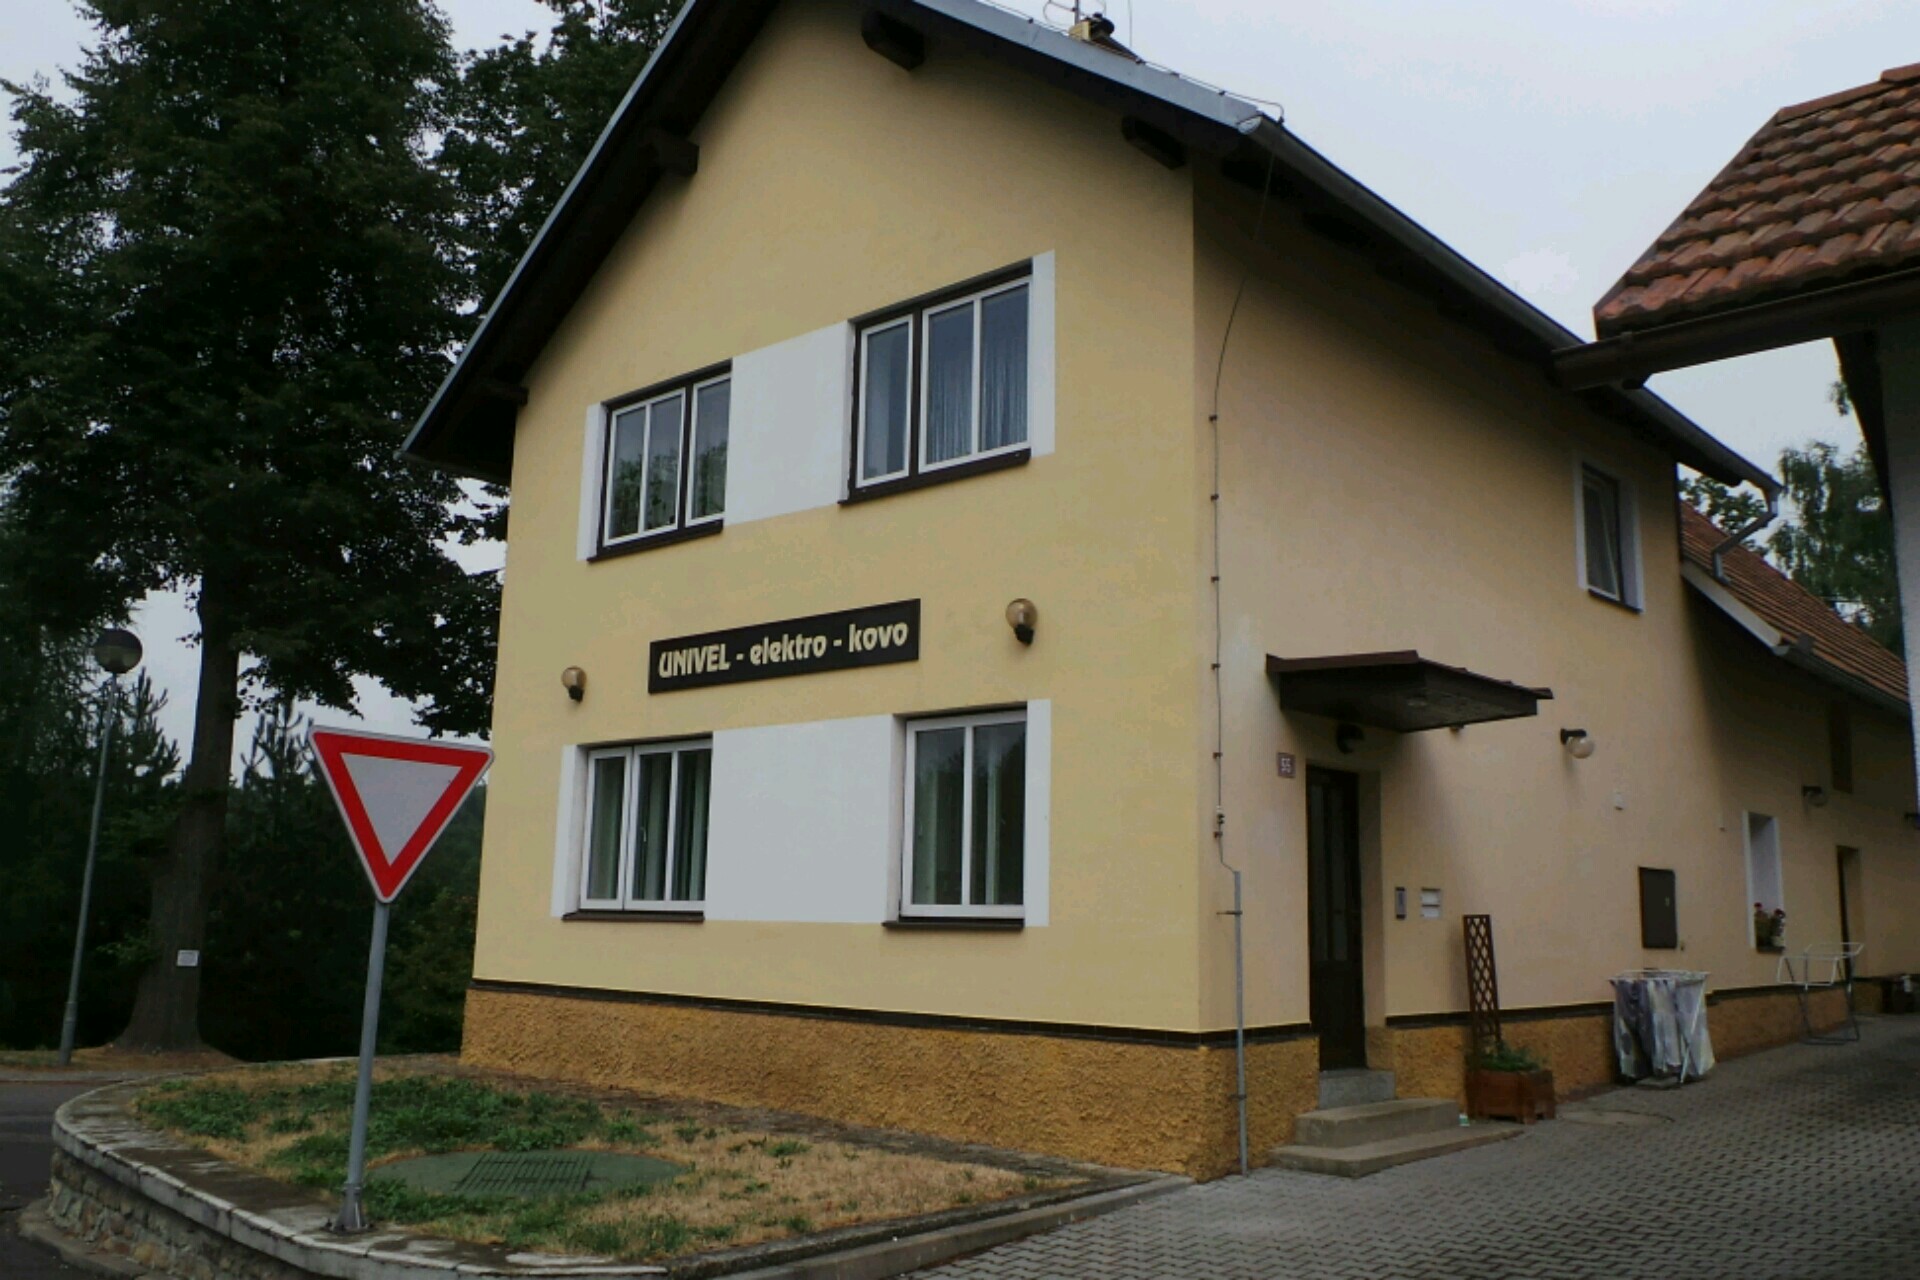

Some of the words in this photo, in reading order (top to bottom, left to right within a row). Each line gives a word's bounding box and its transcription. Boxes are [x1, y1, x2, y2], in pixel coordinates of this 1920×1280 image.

[658, 643, 731, 678] UNIVEL
[750, 634, 827, 666] elektro
[849, 622, 909, 653] kovo
